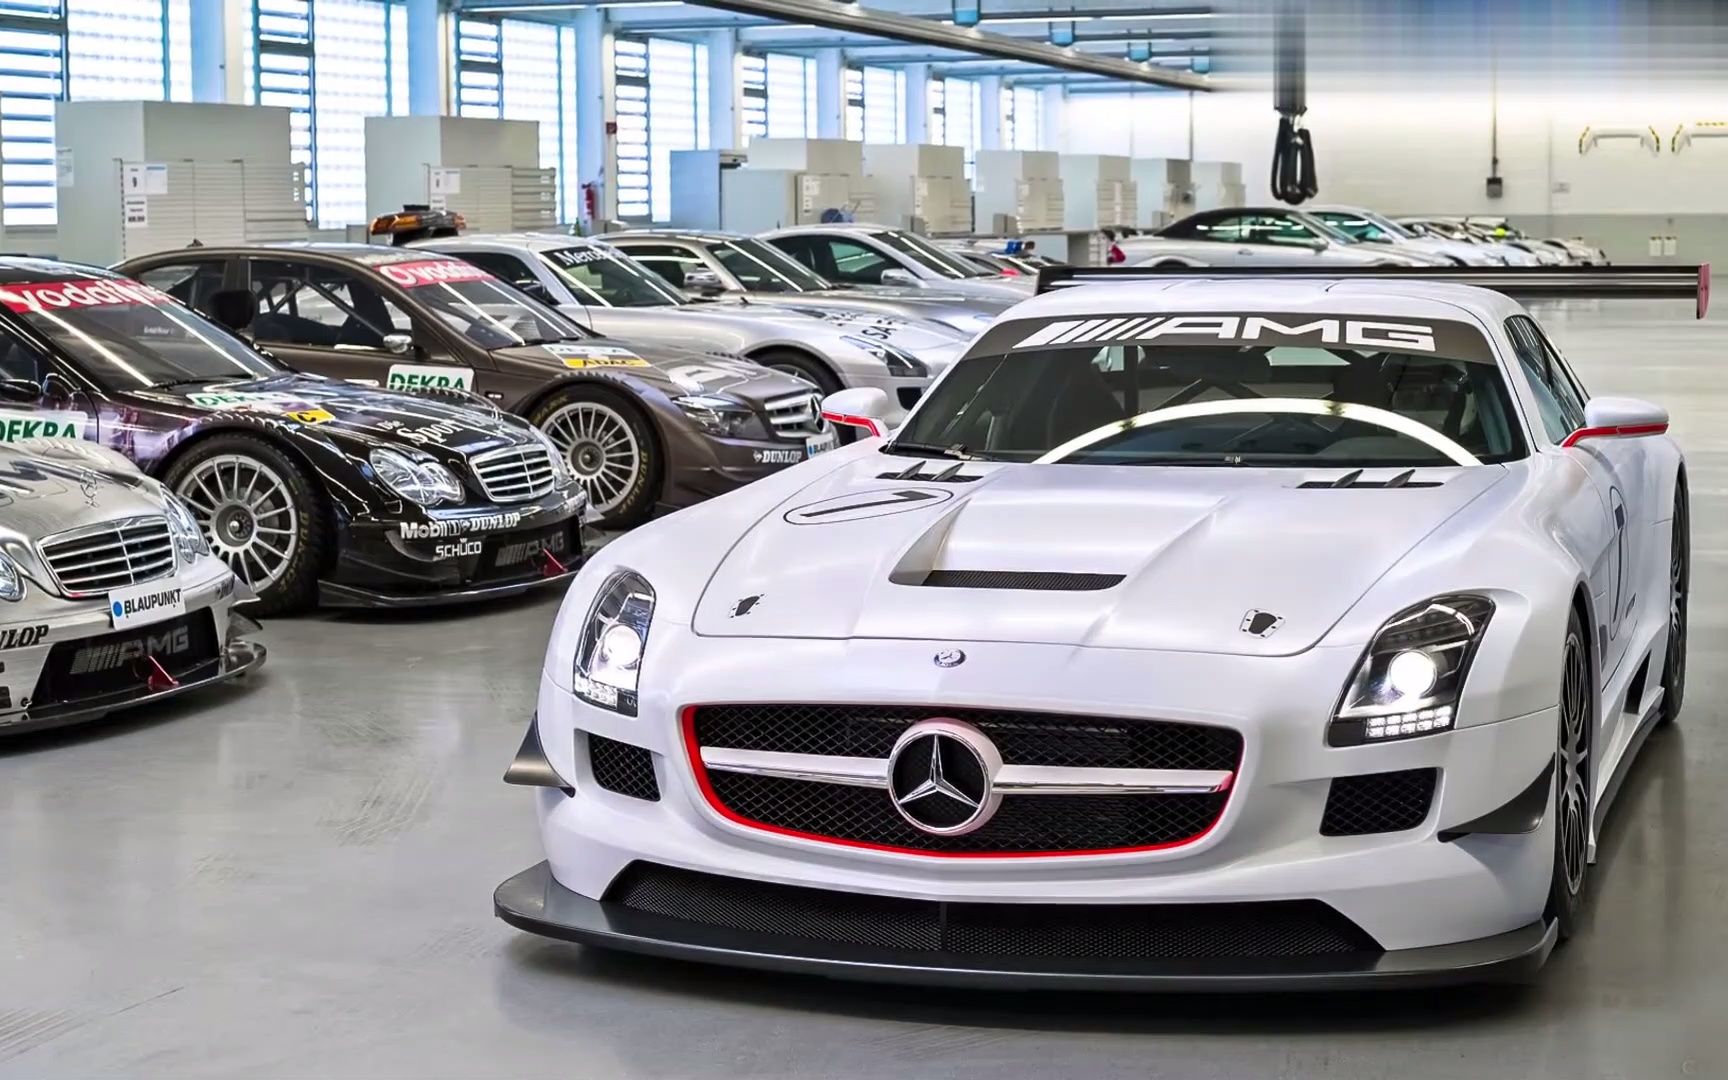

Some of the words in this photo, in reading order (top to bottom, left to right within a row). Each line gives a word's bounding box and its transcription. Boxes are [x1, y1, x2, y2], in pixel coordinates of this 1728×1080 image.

[1135, 316, 1437, 352] AMG
[762, 450, 802, 464] DUNLOP
[400, 519, 447, 539] Mobil
[469, 512, 521, 532] DUNLOP
[123, 588, 182, 615] BLAUPUNKT
